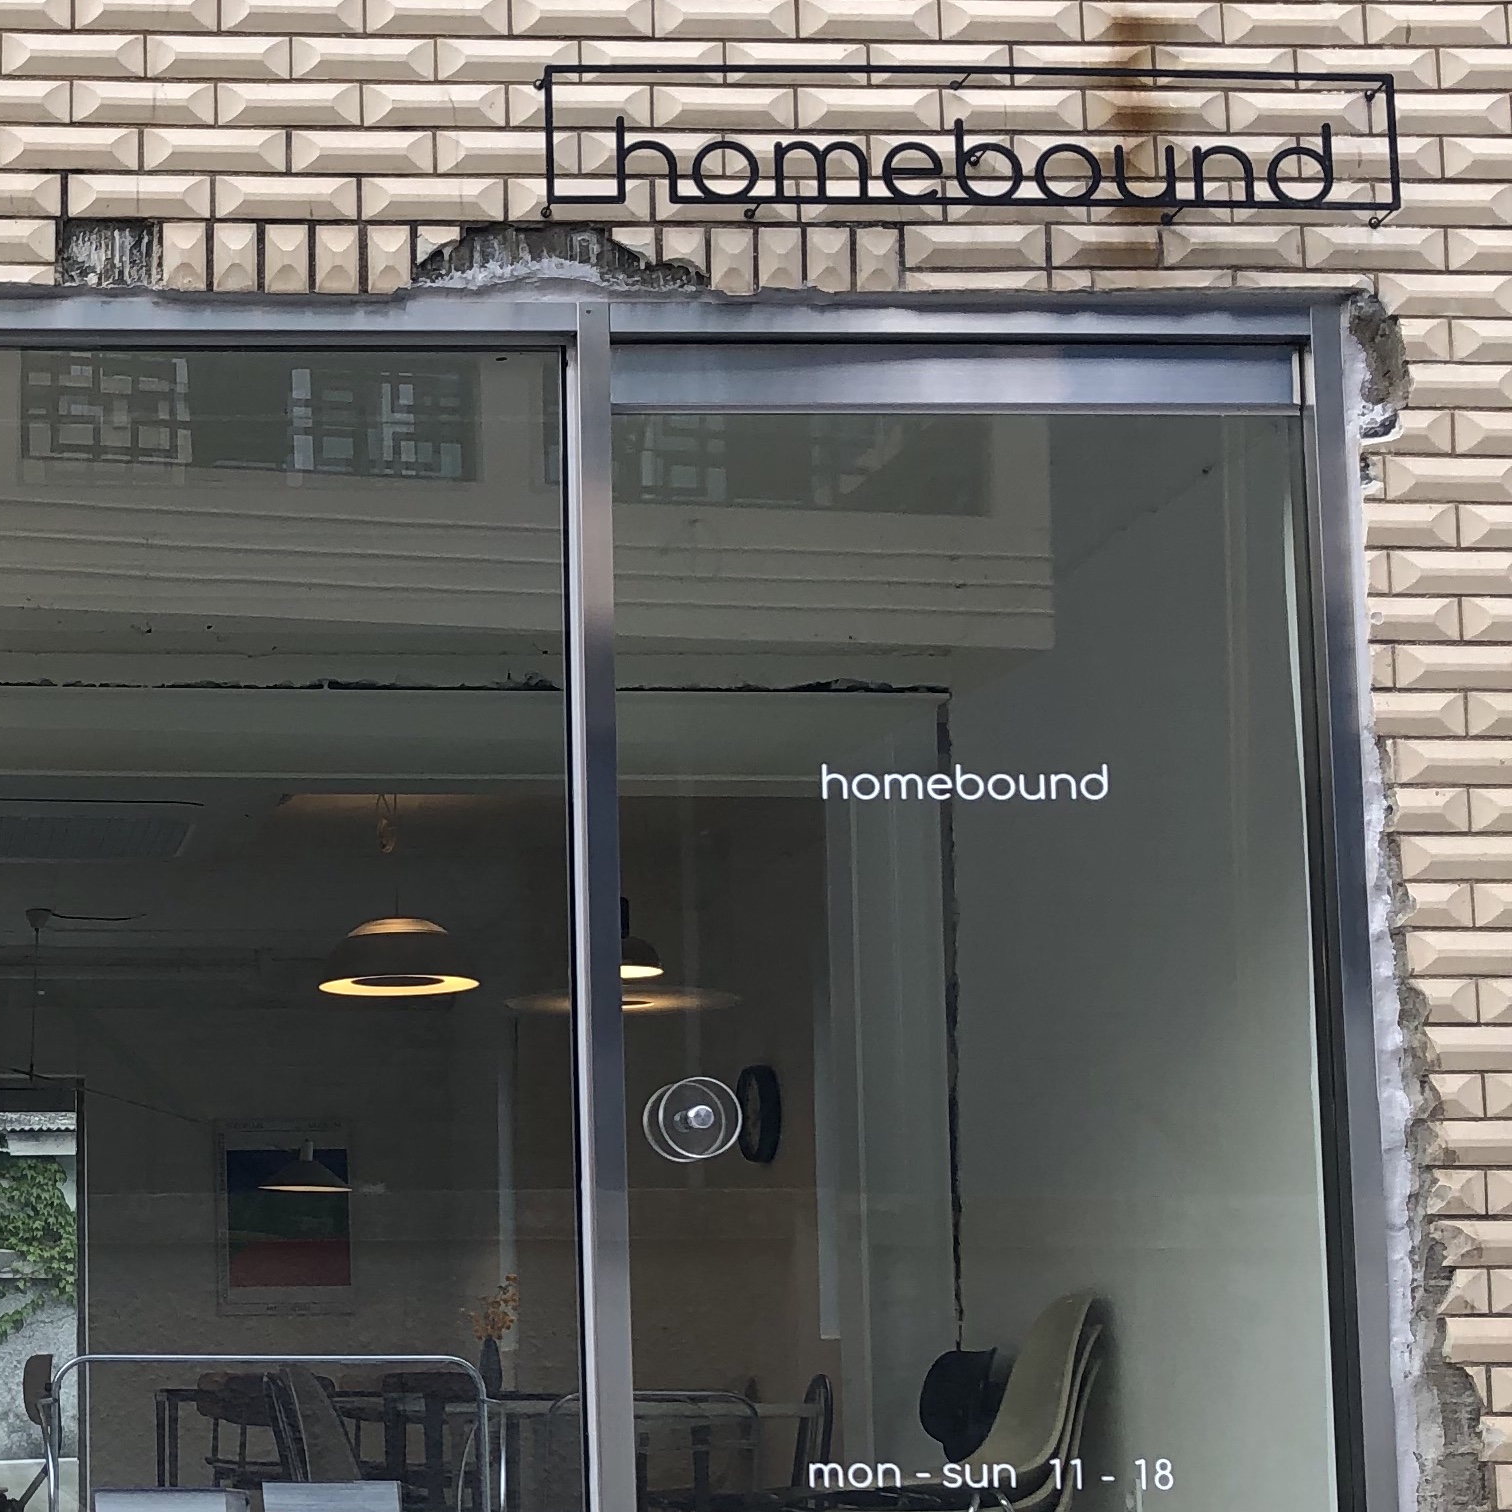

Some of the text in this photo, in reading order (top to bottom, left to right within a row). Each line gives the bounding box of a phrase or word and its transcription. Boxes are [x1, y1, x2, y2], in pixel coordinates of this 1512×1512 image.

[616, 117, 1334, 207] homebound
[821, 764, 1108, 799] homebound
[808, 1461, 902, 1489] mon
[943, 1461, 1017, 1488] sun
[1049, 1458, 1083, 1490] 11
[1134, 1458, 1175, 1491] 18
